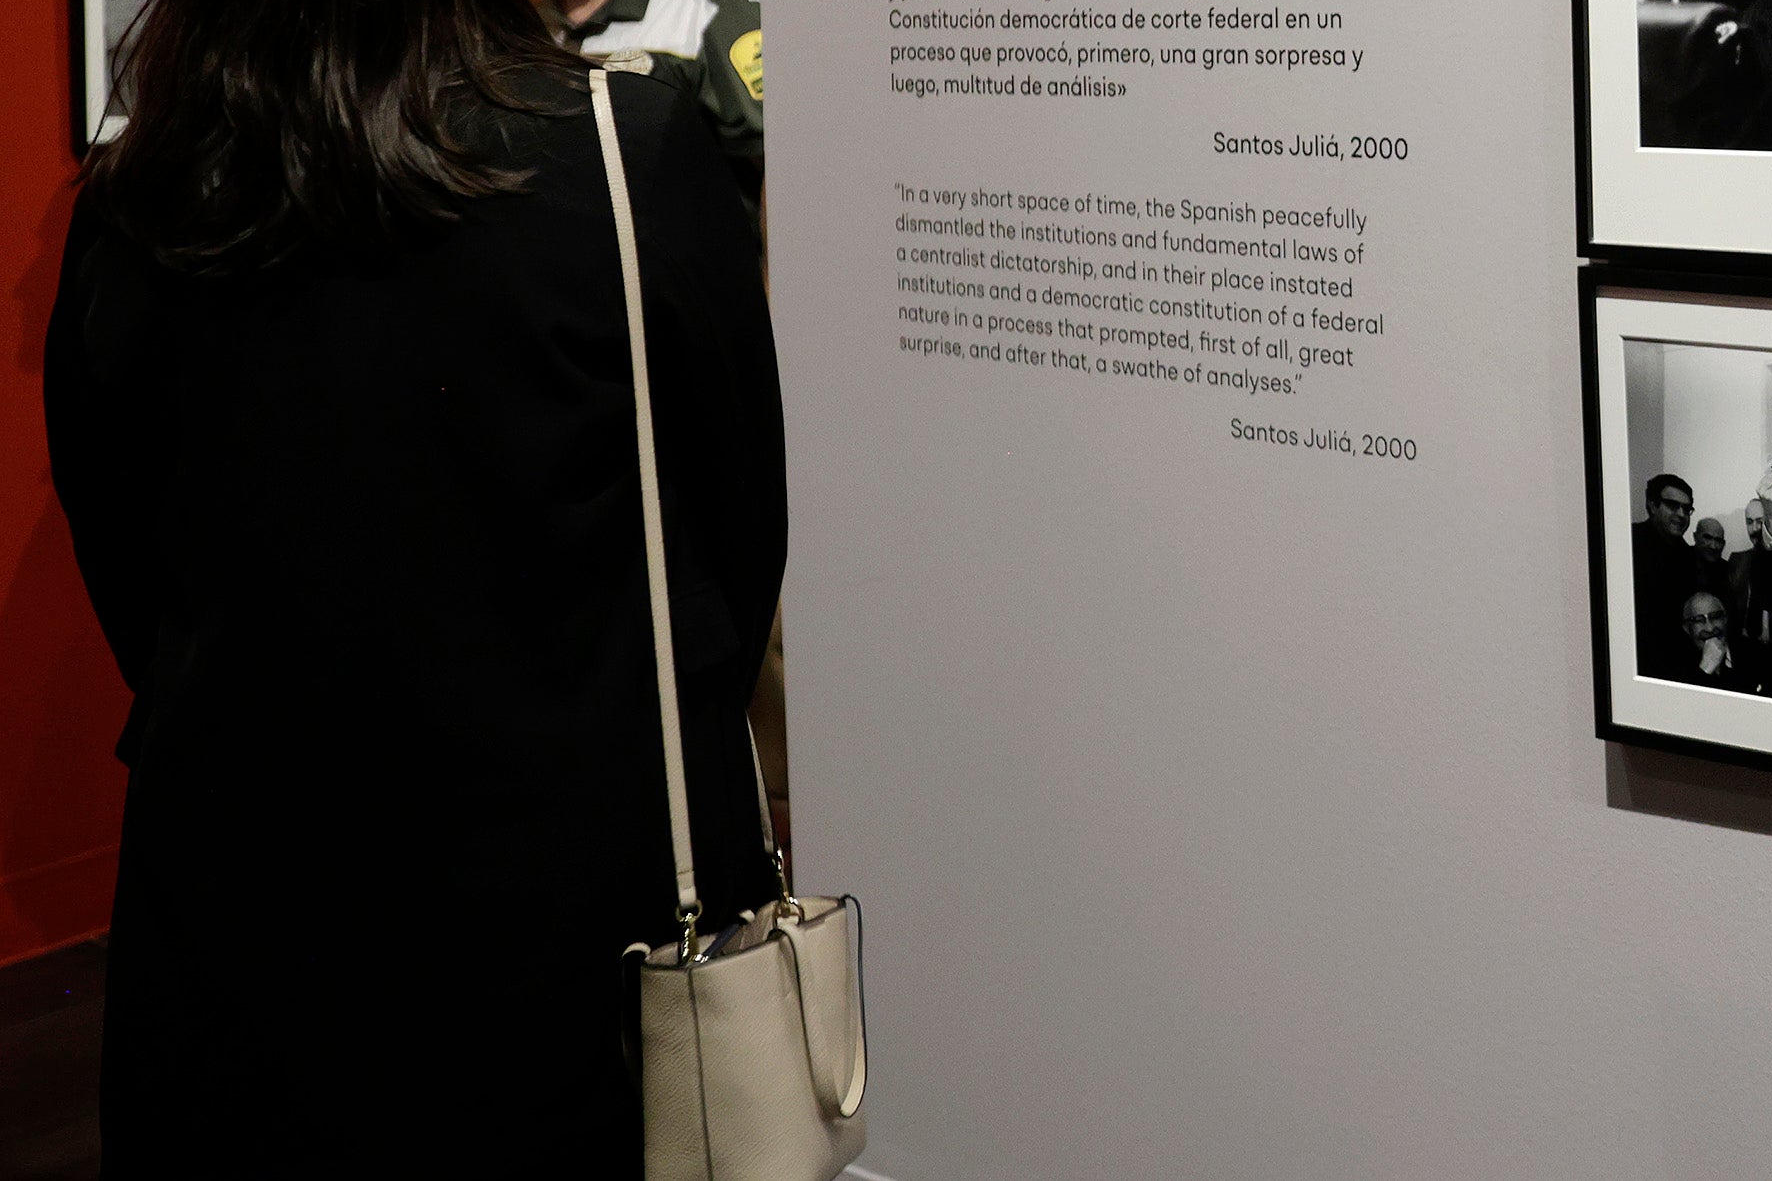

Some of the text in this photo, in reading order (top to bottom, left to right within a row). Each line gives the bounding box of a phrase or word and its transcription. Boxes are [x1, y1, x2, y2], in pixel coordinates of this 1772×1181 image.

[890, 7, 1341, 29] Constitución democrática de corte federal en un
[891, 41, 1363, 71] proceso que provocó, primero, una gran sorpresa y
[892, 73, 1126, 98] luego, multitud de análisis»
[1214, 132, 1408, 161] Santos Juliá, 2000
[920, 189, 928, 203] a
[934, 191, 966, 210] very
[972, 187, 1012, 209] short
[1018, 195, 1069, 214] space
[1075, 193, 1091, 213] of
[1097, 195, 1140, 219] time,
[1146, 197, 1174, 218] the
[1181, 199, 1256, 225] Spanish
[1263, 207, 1366, 235] peacefully
[896, 213, 1364, 263] dismantled the institutions and fundamental laws of
[897, 247, 1352, 297] a centralist dictatorship, and in their place instated
[898, 273, 1382, 335] institutions and a democratic constitution of a federal
[899, 307, 1353, 367] nature in a process that prompted, first of all, great
[900, 336, 964, 359] surprise,
[970, 343, 1000, 361] and
[1006, 344, 1046, 365] after
[1052, 349, 1090, 373] that,
[1096, 358, 1106, 373] a
[1113, 359, 1178, 381] swathe
[1184, 363, 1201, 383] of
[1232, 418, 1416, 460] Santos Juliá, 2000
